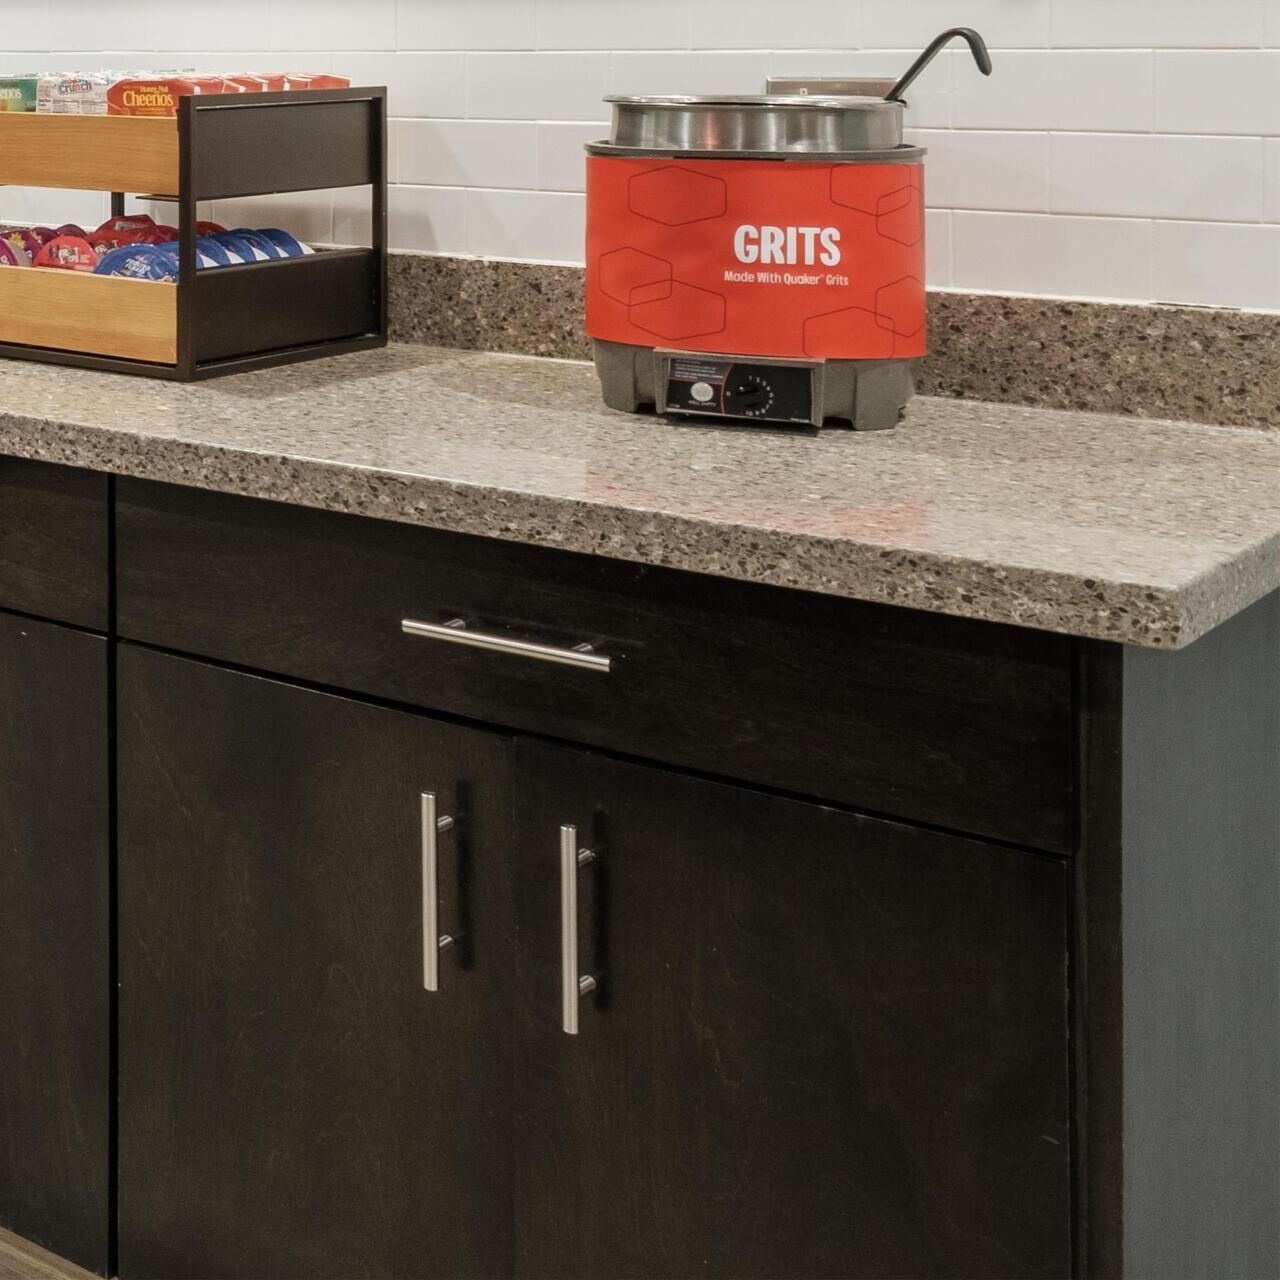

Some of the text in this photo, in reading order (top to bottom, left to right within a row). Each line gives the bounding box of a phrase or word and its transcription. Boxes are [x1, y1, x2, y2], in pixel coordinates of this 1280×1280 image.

[123, 90, 174, 106] Cheerios
[734, 224, 841, 266] GRITS
[724, 271, 849, 286] Made With Quaker Grits
